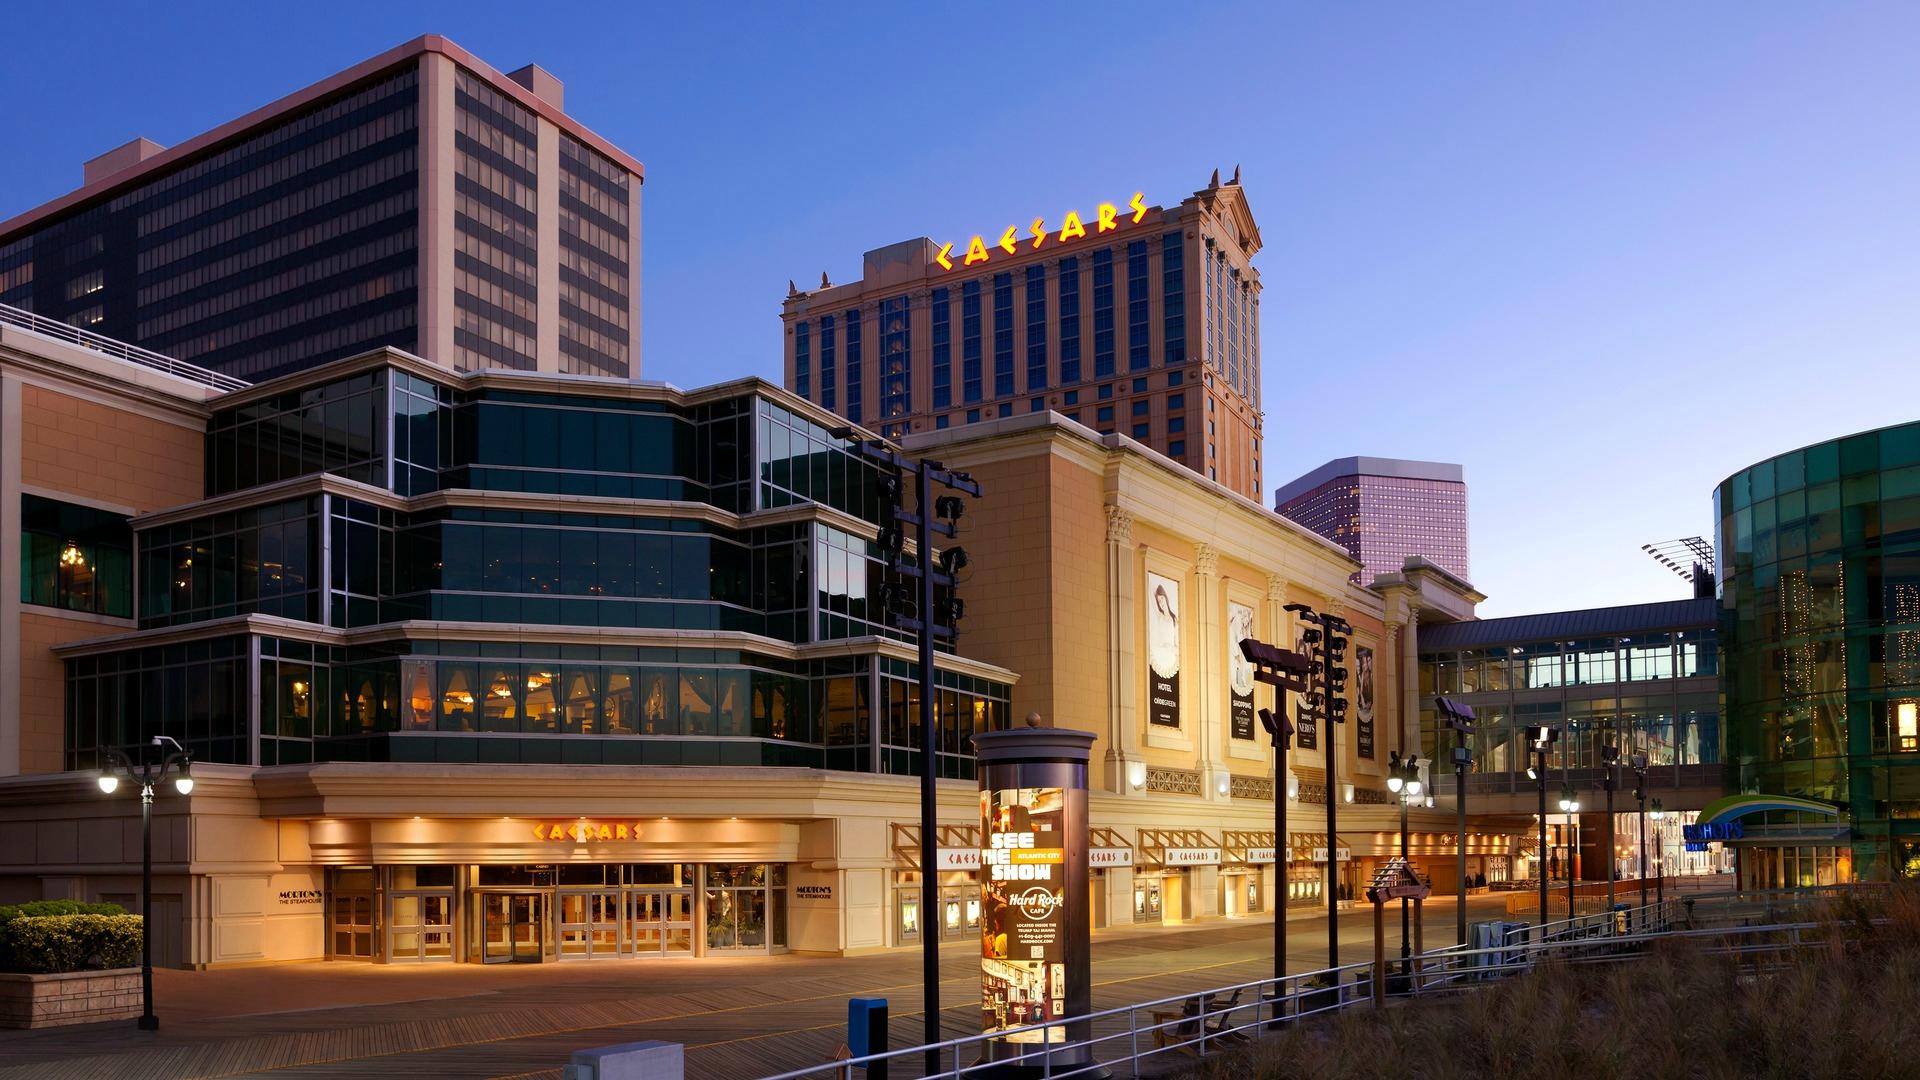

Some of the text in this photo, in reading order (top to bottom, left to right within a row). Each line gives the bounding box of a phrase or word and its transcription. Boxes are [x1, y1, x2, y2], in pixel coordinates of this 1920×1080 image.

[935, 191, 1149, 271] CAESARS
[1157, 682, 1172, 692] HOTEL
[1232, 699, 1252, 710] SHOPPING
[1298, 722, 1315, 734] NERO'S
[533, 823, 642, 840] CAESARS
[992, 832, 1034, 848] SEE
[949, 854, 980, 864] CAES
[981, 849, 1011, 865] THE
[1090, 852, 1117, 862] ESARS
[1179, 851, 1209, 861] CAESARS
[992, 864, 1052, 880] SHOW
[1009, 893, 1064, 908] Hard Rock
